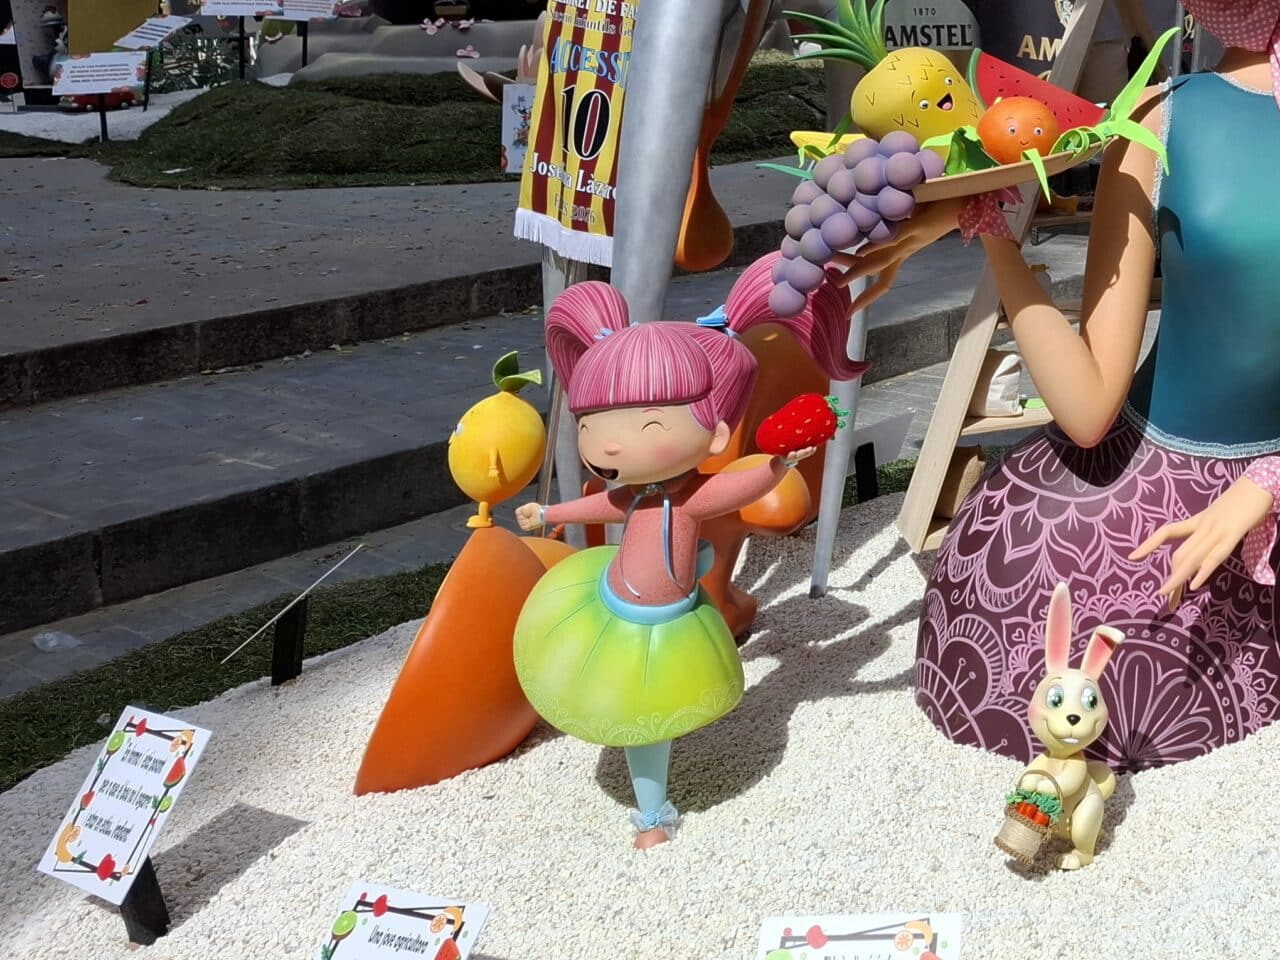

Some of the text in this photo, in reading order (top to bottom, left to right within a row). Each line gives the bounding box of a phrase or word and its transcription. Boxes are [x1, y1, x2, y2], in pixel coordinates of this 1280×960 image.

[913, 7, 936, 16] 1870
[884, 24, 973, 47] AMSTEL
[561, 84, 611, 160] 10
[368, 925, 382, 944] Una
